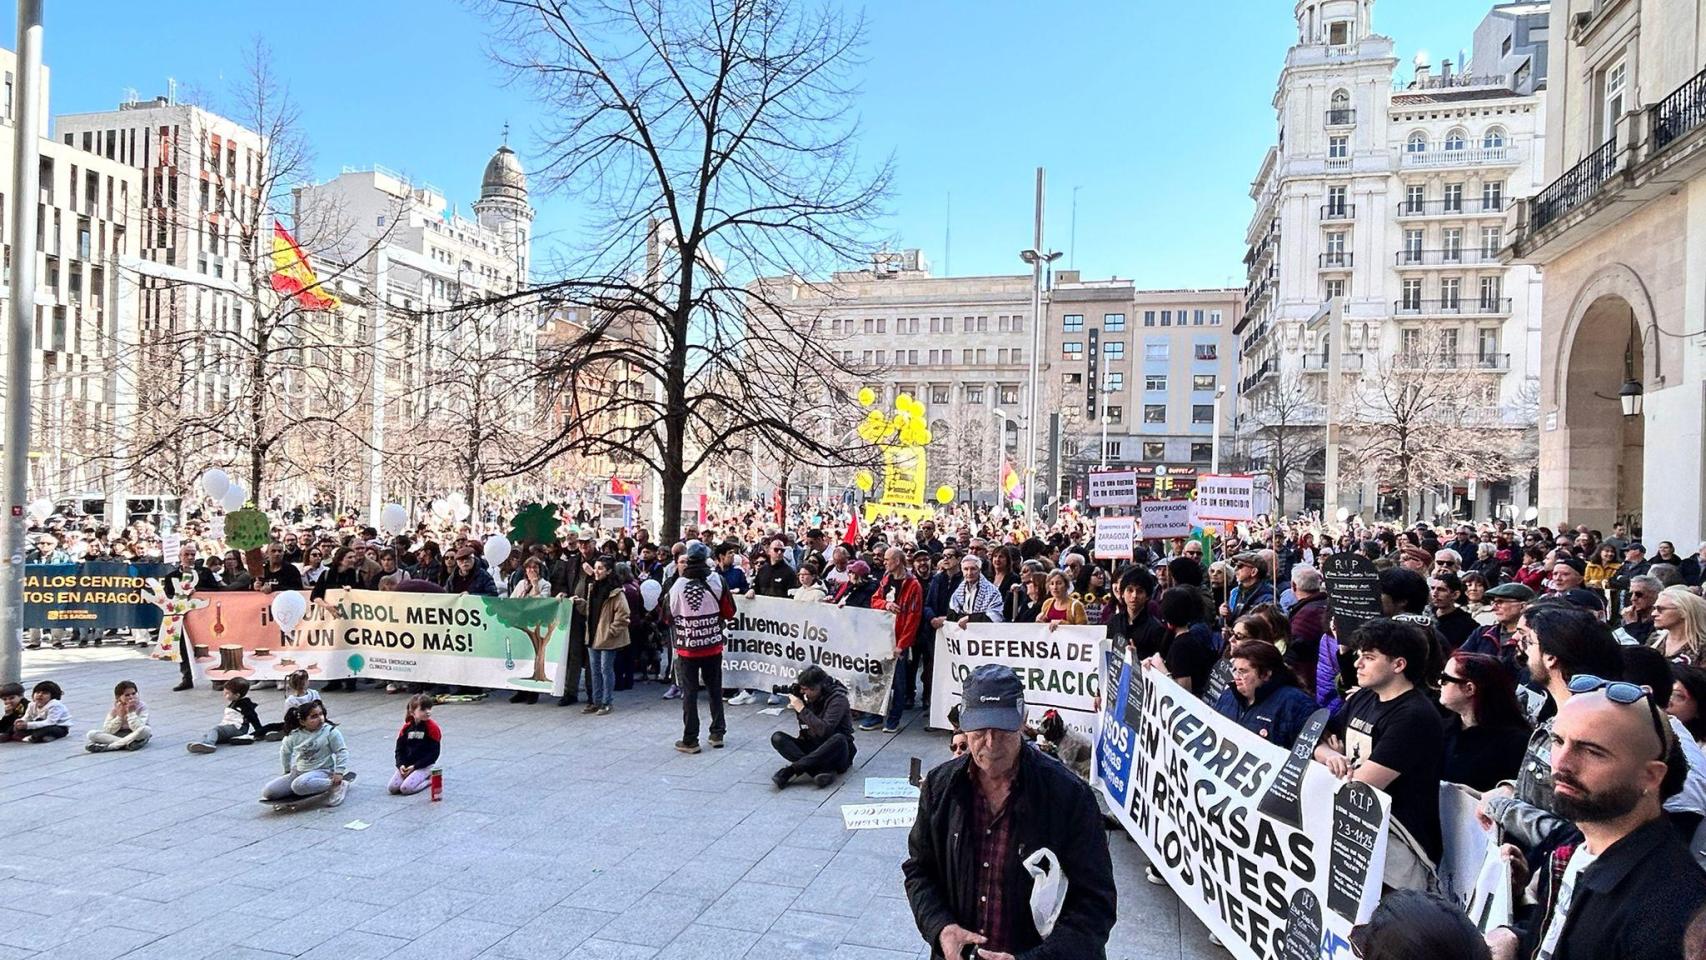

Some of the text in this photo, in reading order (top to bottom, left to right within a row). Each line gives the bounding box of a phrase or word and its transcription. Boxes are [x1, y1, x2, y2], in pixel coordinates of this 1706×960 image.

[1109, 489, 1134, 497] GENOCIDIO
[1201, 486, 1249, 495] NO ES UNA GUERRA
[1144, 503, 1186, 513] COOPERACIÓN
[1201, 498, 1249, 508] ES UN GENOCIDIO
[1099, 532, 1130, 540] ZARAGOZA
[1099, 543, 1129, 551] SOLIDARIA
[43, 575, 77, 588] LOS
[57, 592, 82, 604] EN
[334, 597, 400, 623] ÁRBOL
[406, 606, 488, 631] MENOS,
[684, 624, 721, 638] Pinares
[802, 620, 828, 643] los
[307, 629, 334, 647] UN
[344, 627, 415, 650] GRADO
[422, 628, 474, 653] MÁS!
[946, 637, 1094, 662] EN DEFENSA DE
[785, 641, 806, 662] de
[808, 644, 884, 675] Venecia
[779, 666, 796, 679] NO
[1143, 676, 1158, 718] NI
[1160, 694, 1272, 799] CIERRES
[1139, 713, 1160, 761] EN
[1162, 733, 1190, 799] LAS
[1195, 778, 1317, 883] CASAS
[1129, 786, 1151, 836] EN
[1153, 816, 1195, 886] LOS
[1136, 750, 1150, 793] NI
[1151, 770, 1291, 920] RECORTES
